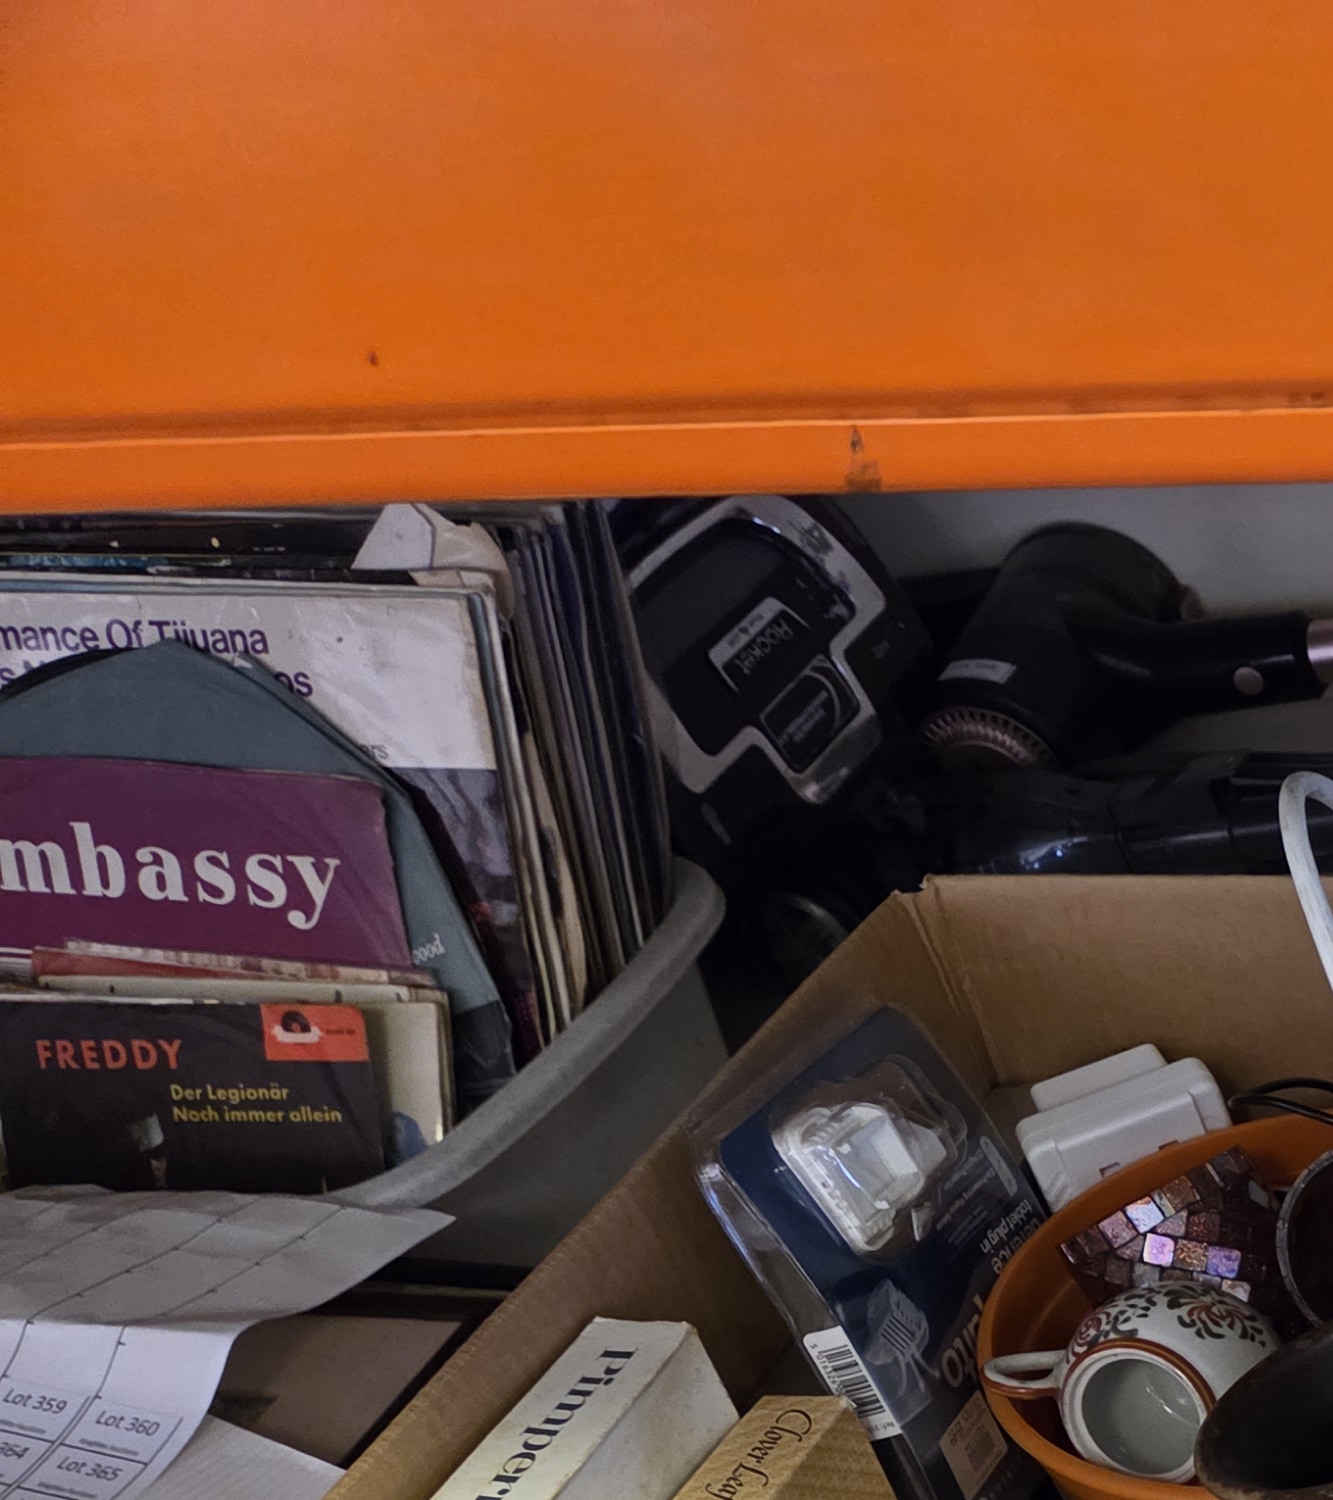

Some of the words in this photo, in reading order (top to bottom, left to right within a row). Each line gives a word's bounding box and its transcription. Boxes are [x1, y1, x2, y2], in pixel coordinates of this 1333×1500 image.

[106, 618, 144, 650] Of
[0, 821, 340, 930] mbassy
[36, 1038, 182, 1070] FREDDY
[170, 1083, 203, 1102] Der
[206, 1082, 290, 1105] Legionär
[173, 1105, 219, 1123] Noch
[223, 1106, 284, 1124] immer
[289, 1105, 342, 1123] allein
[1004, 1199, 1034, 1229] tablet
[3, 1387, 33, 1409] Lot
[32, 1393, 68, 1417] 359
[95, 1409, 124, 1430] Lot
[124, 1415, 161, 1439] 360
[746, 1408, 813, 1462] Clover
[56, 1454, 85, 1475] Lot
[85, 1461, 123, 1485] 365
